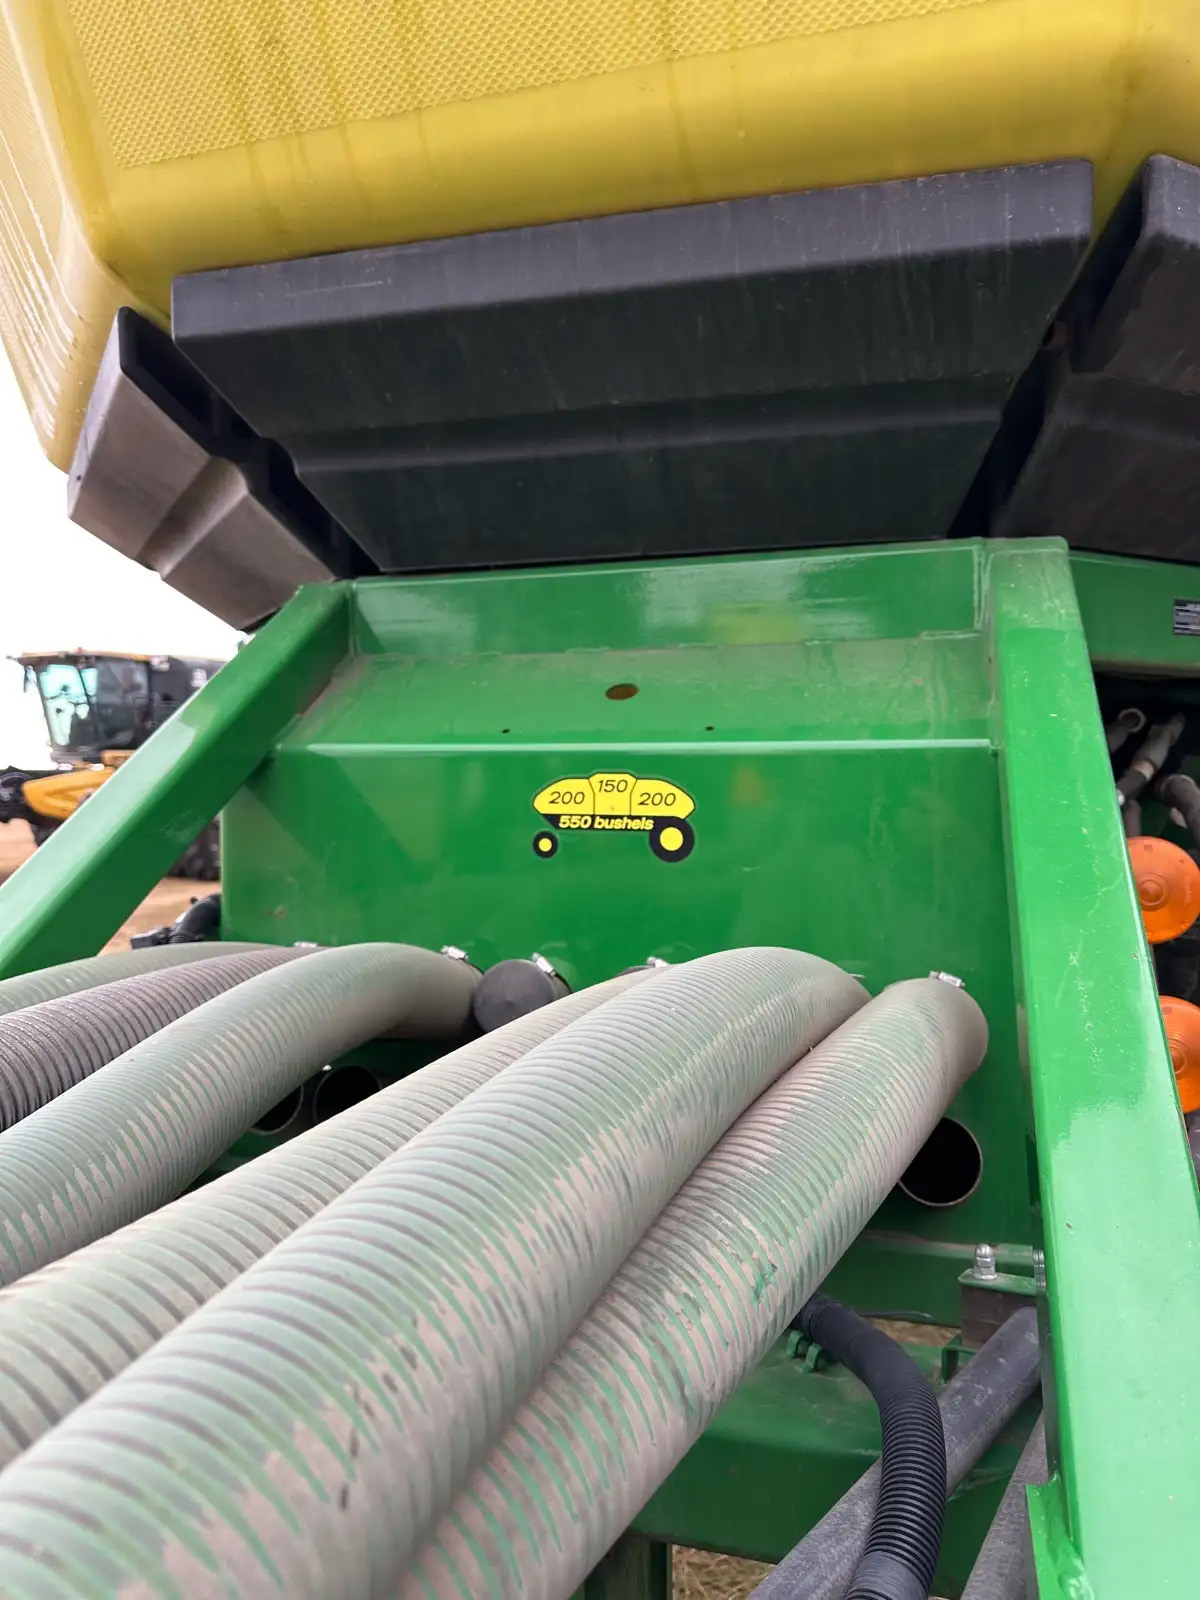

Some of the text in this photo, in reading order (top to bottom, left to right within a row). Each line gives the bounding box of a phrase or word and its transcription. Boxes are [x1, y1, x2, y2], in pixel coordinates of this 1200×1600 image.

[598, 779, 628, 793] 150
[549, 791, 585, 805] 200
[638, 792, 676, 806] 200
[558, 815, 655, 831] 550 bushels
